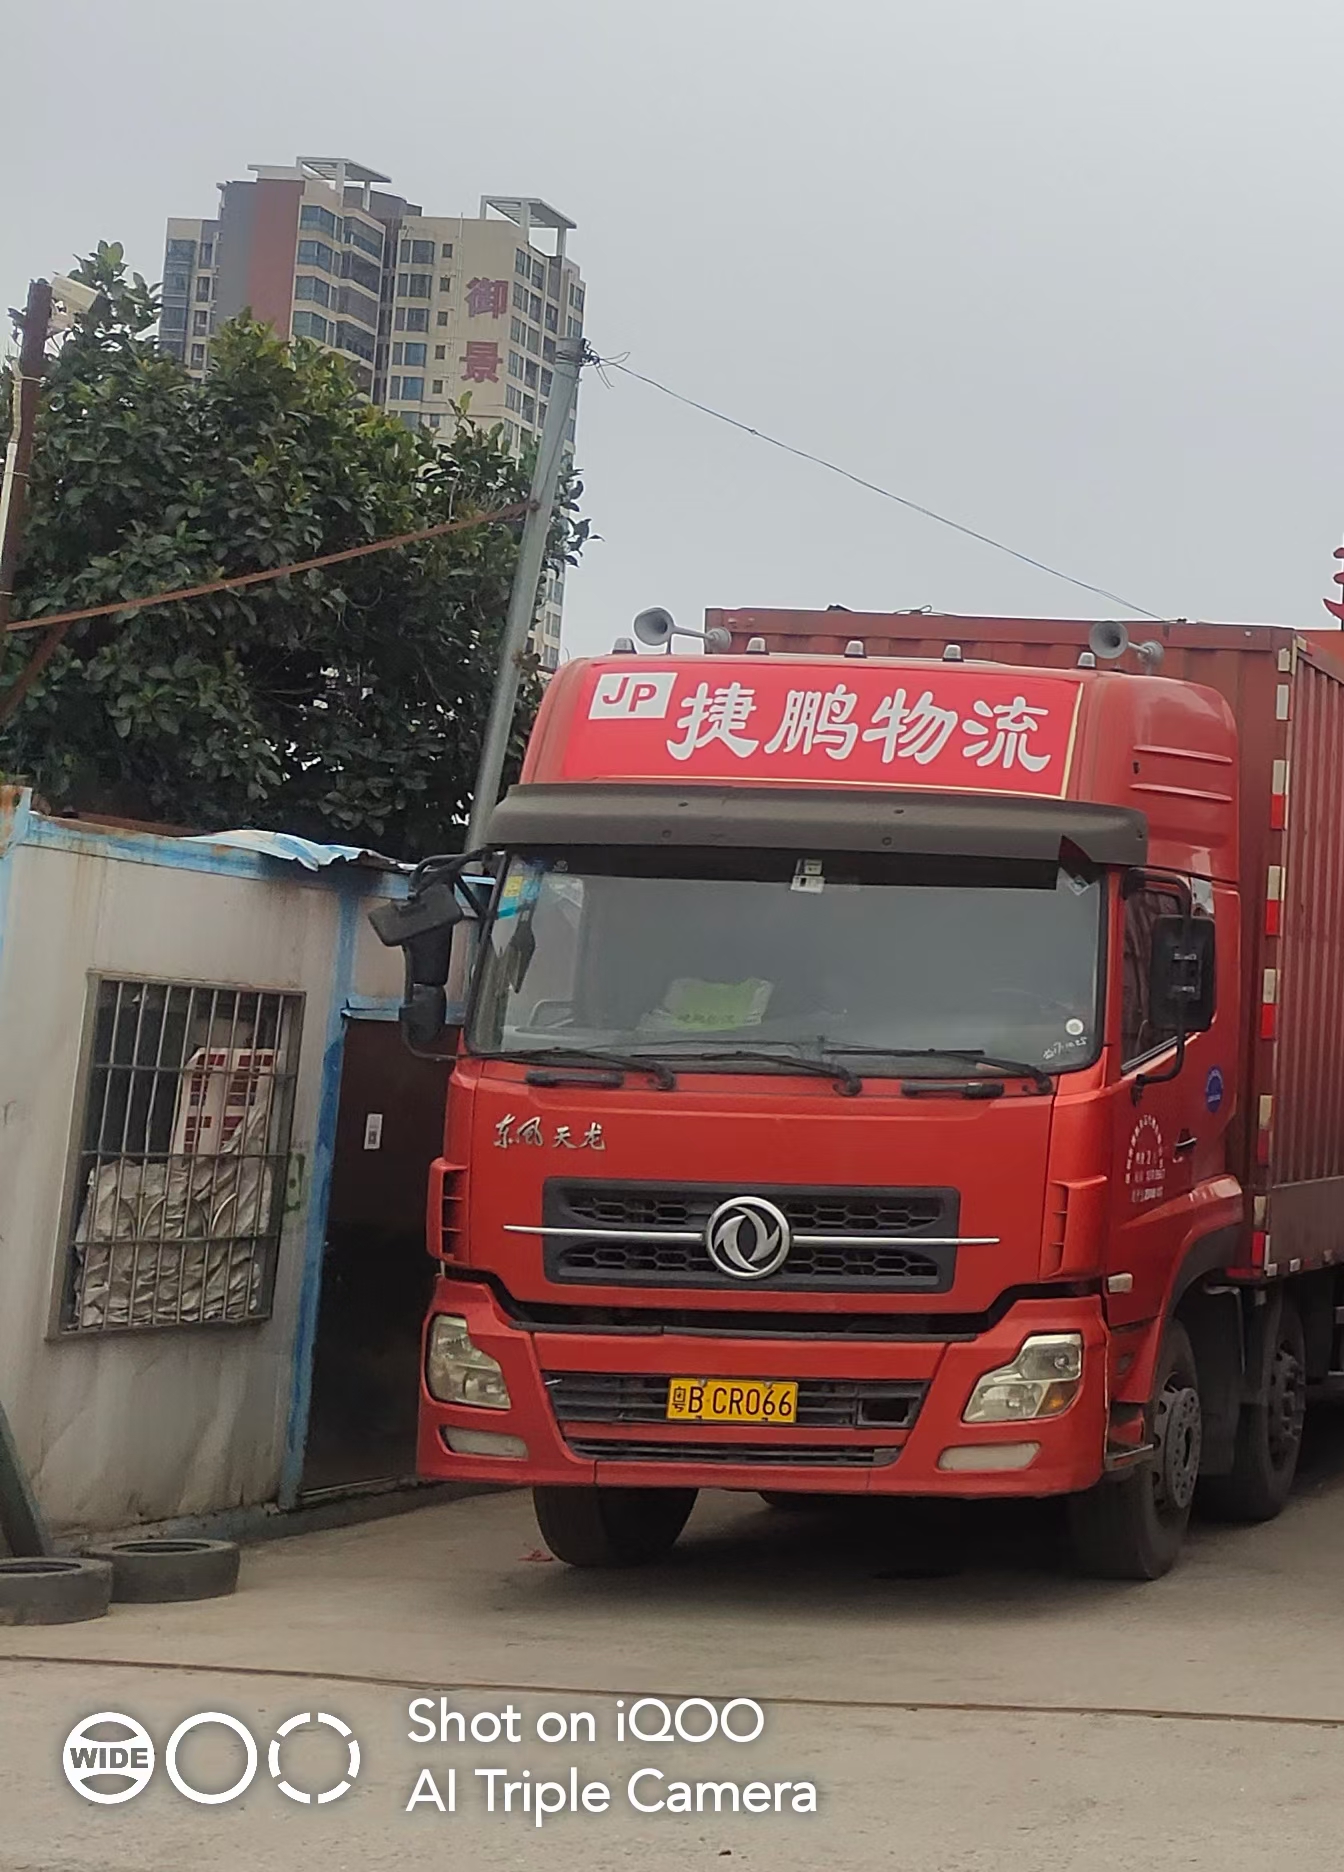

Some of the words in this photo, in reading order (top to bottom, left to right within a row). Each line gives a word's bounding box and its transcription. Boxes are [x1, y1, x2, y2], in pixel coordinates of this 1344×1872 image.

[460, 277, 508, 383] 御景
[602, 677, 657, 713] JP
[666, 683, 1052, 772] 捷鹏物流
